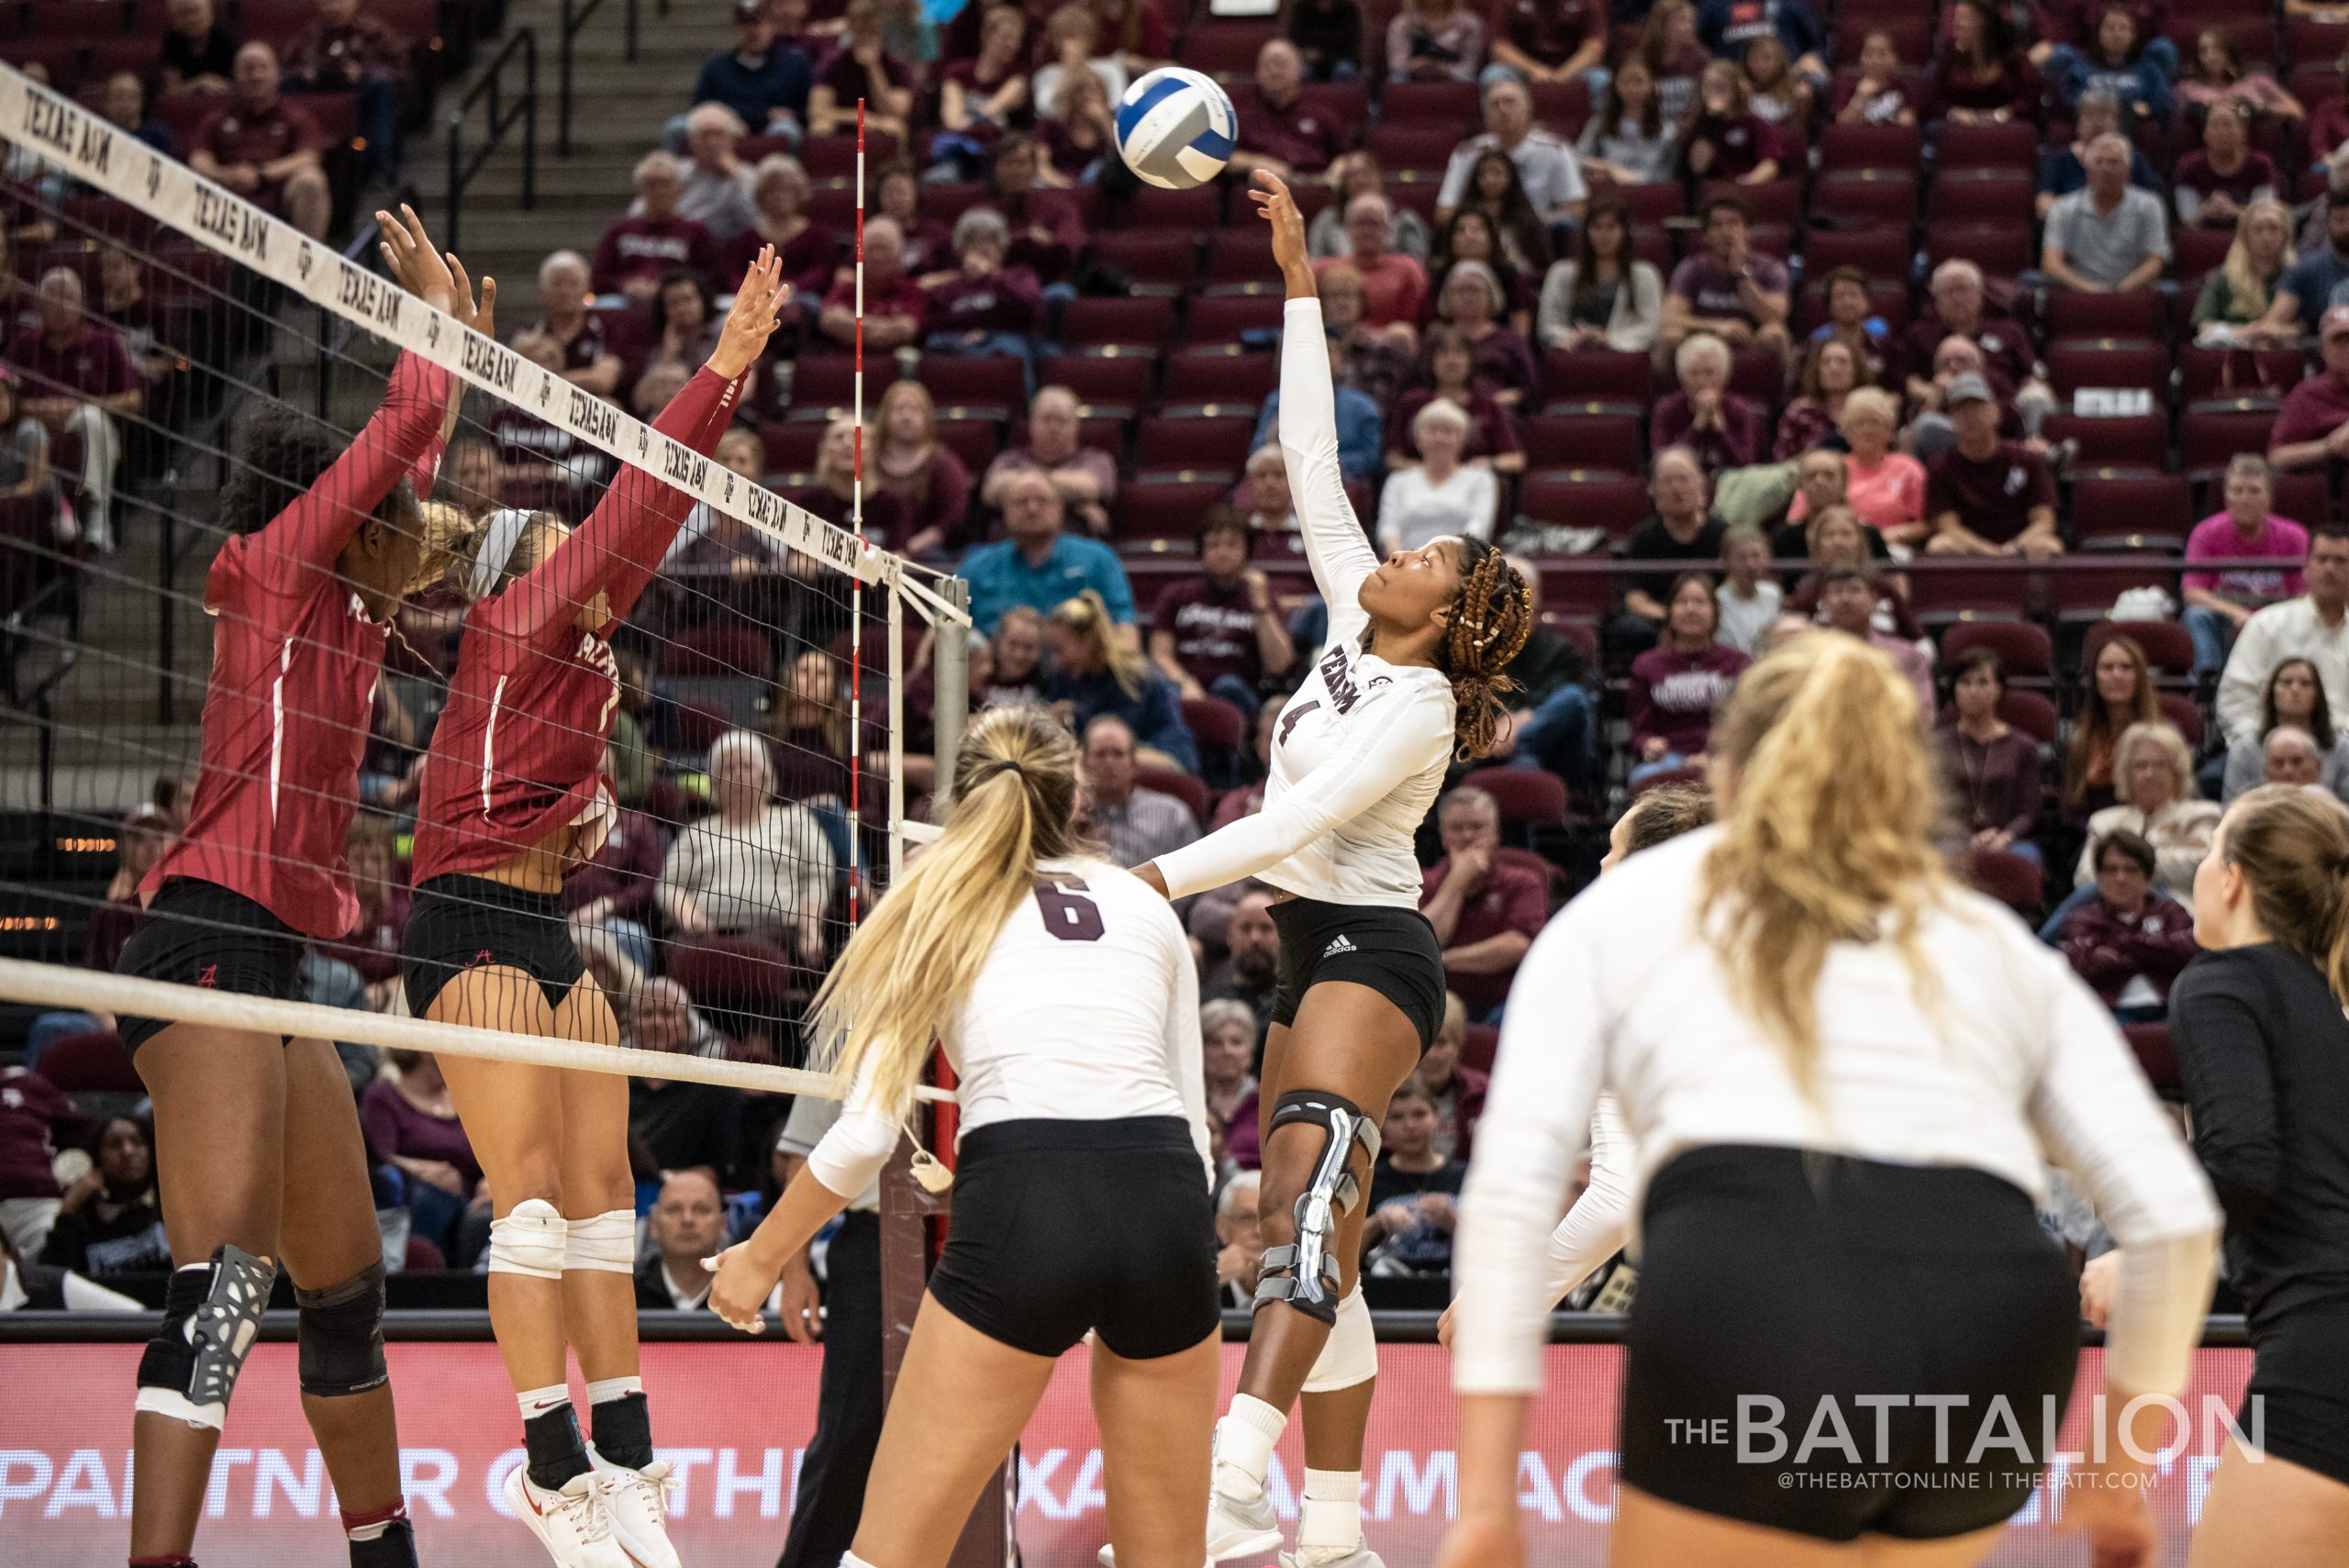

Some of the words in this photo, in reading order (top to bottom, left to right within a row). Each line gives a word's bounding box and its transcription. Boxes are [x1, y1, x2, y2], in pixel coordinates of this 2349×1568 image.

[24, 88, 77, 154] TEXAS
[193, 183, 238, 244] TEXAS
[337, 262, 375, 317] TEXAS
[462, 330, 495, 383] TEXAS
[569, 388, 599, 437] TEXAS
[598, 406, 619, 447] A&M
[664, 439, 691, 484] TEXAS
[691, 454, 708, 493] A&M
[749, 485, 771, 526] TEXAS
[822, 525, 843, 561] TEXAS
[1278, 699, 1321, 748] 4
[1031, 871, 1105, 941] 6
[1323, 944, 1357, 958] adidas
[0, 1449, 456, 1519] PATNR
[651, 1449, 806, 1518] TH
